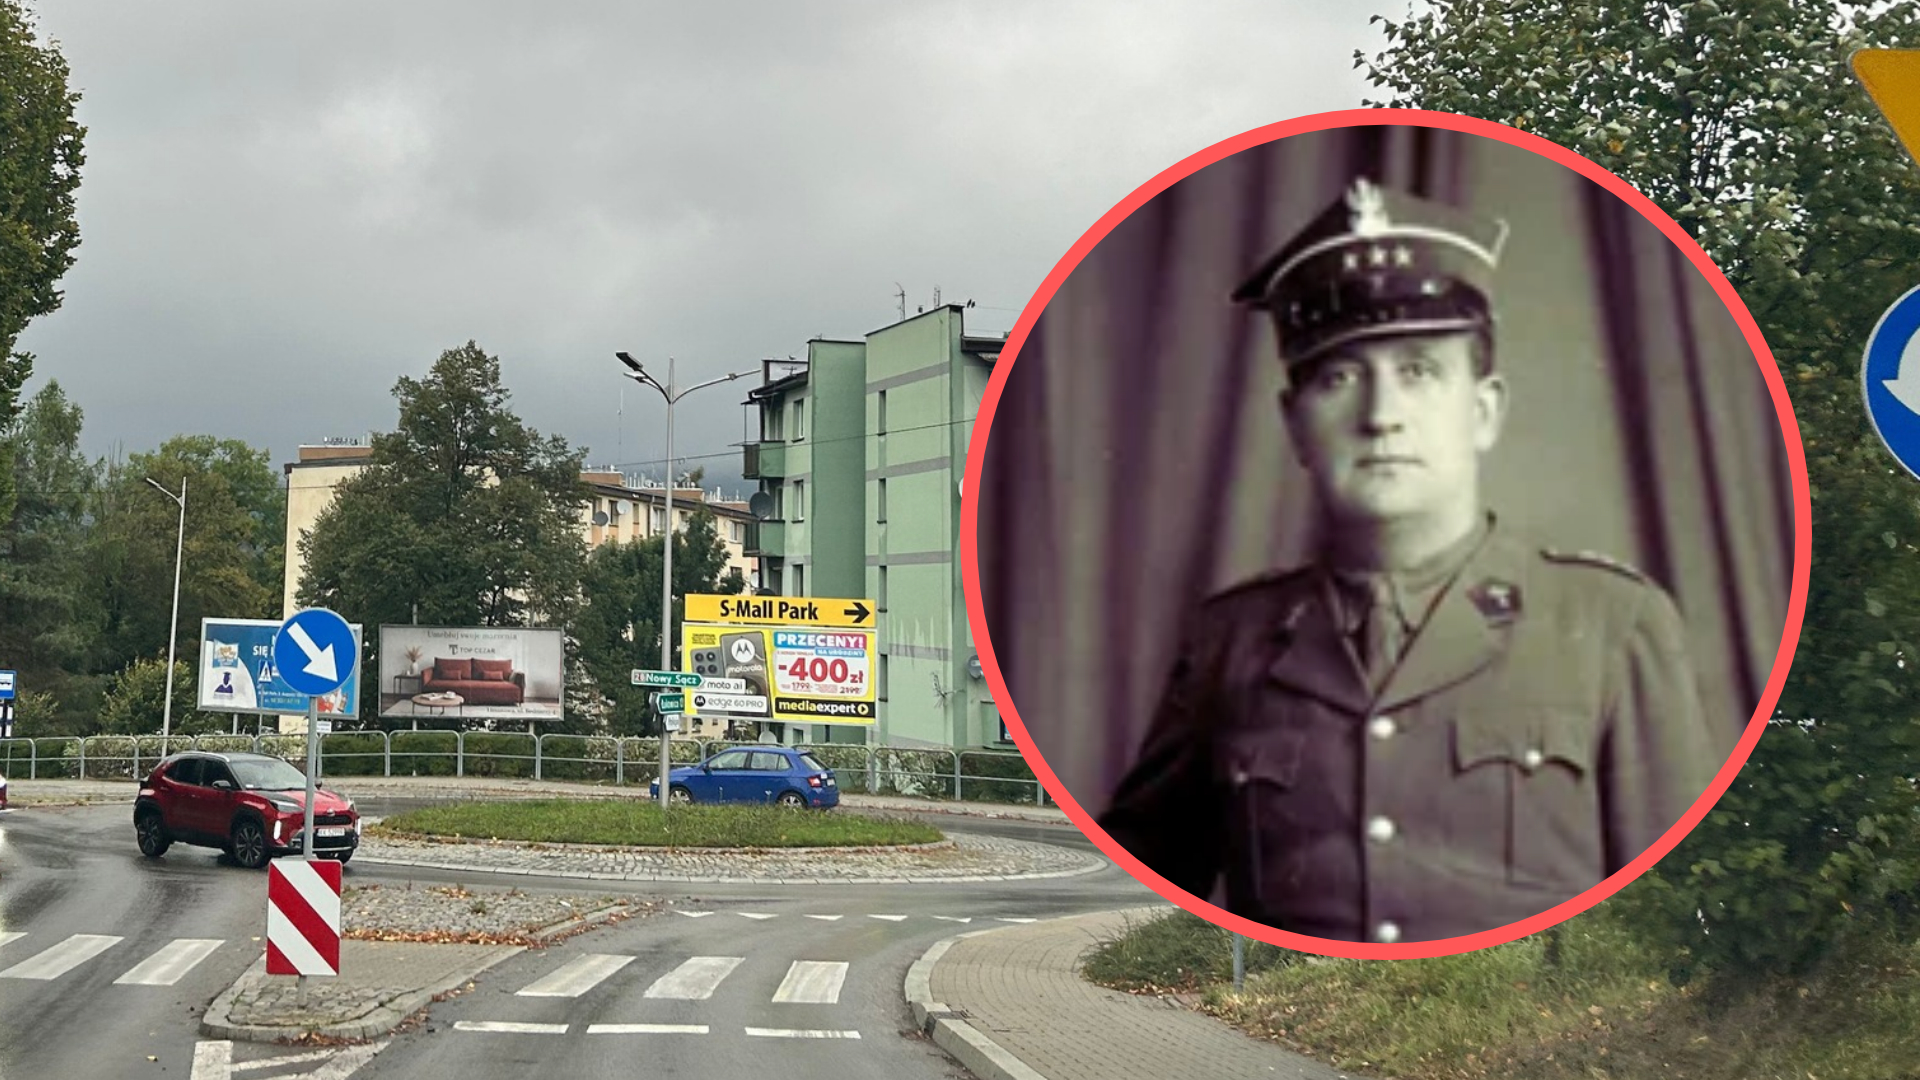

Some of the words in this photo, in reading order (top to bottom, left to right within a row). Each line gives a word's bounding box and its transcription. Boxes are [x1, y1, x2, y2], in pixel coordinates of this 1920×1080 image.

[720, 599, 773, 618] S-Mall
[778, 601, 819, 620] Park
[777, 633, 864, 648] PRZECENY!
[253, 645, 269, 658] SIĘ
[460, 645, 473, 653] TOP
[727, 664, 763, 674] motorola
[778, 657, 849, 684] -400
[850, 670, 864, 684] zł
[646, 673, 672, 685] Nowy
[675, 674, 697, 686] Sącz
[707, 681, 731, 689] moto
[733, 681, 743, 690] ai
[708, 699, 732, 709] edge
[734, 699, 745, 708] 60
[746, 700, 764, 709] PRO
[778, 700, 856, 714] mediaexpert
